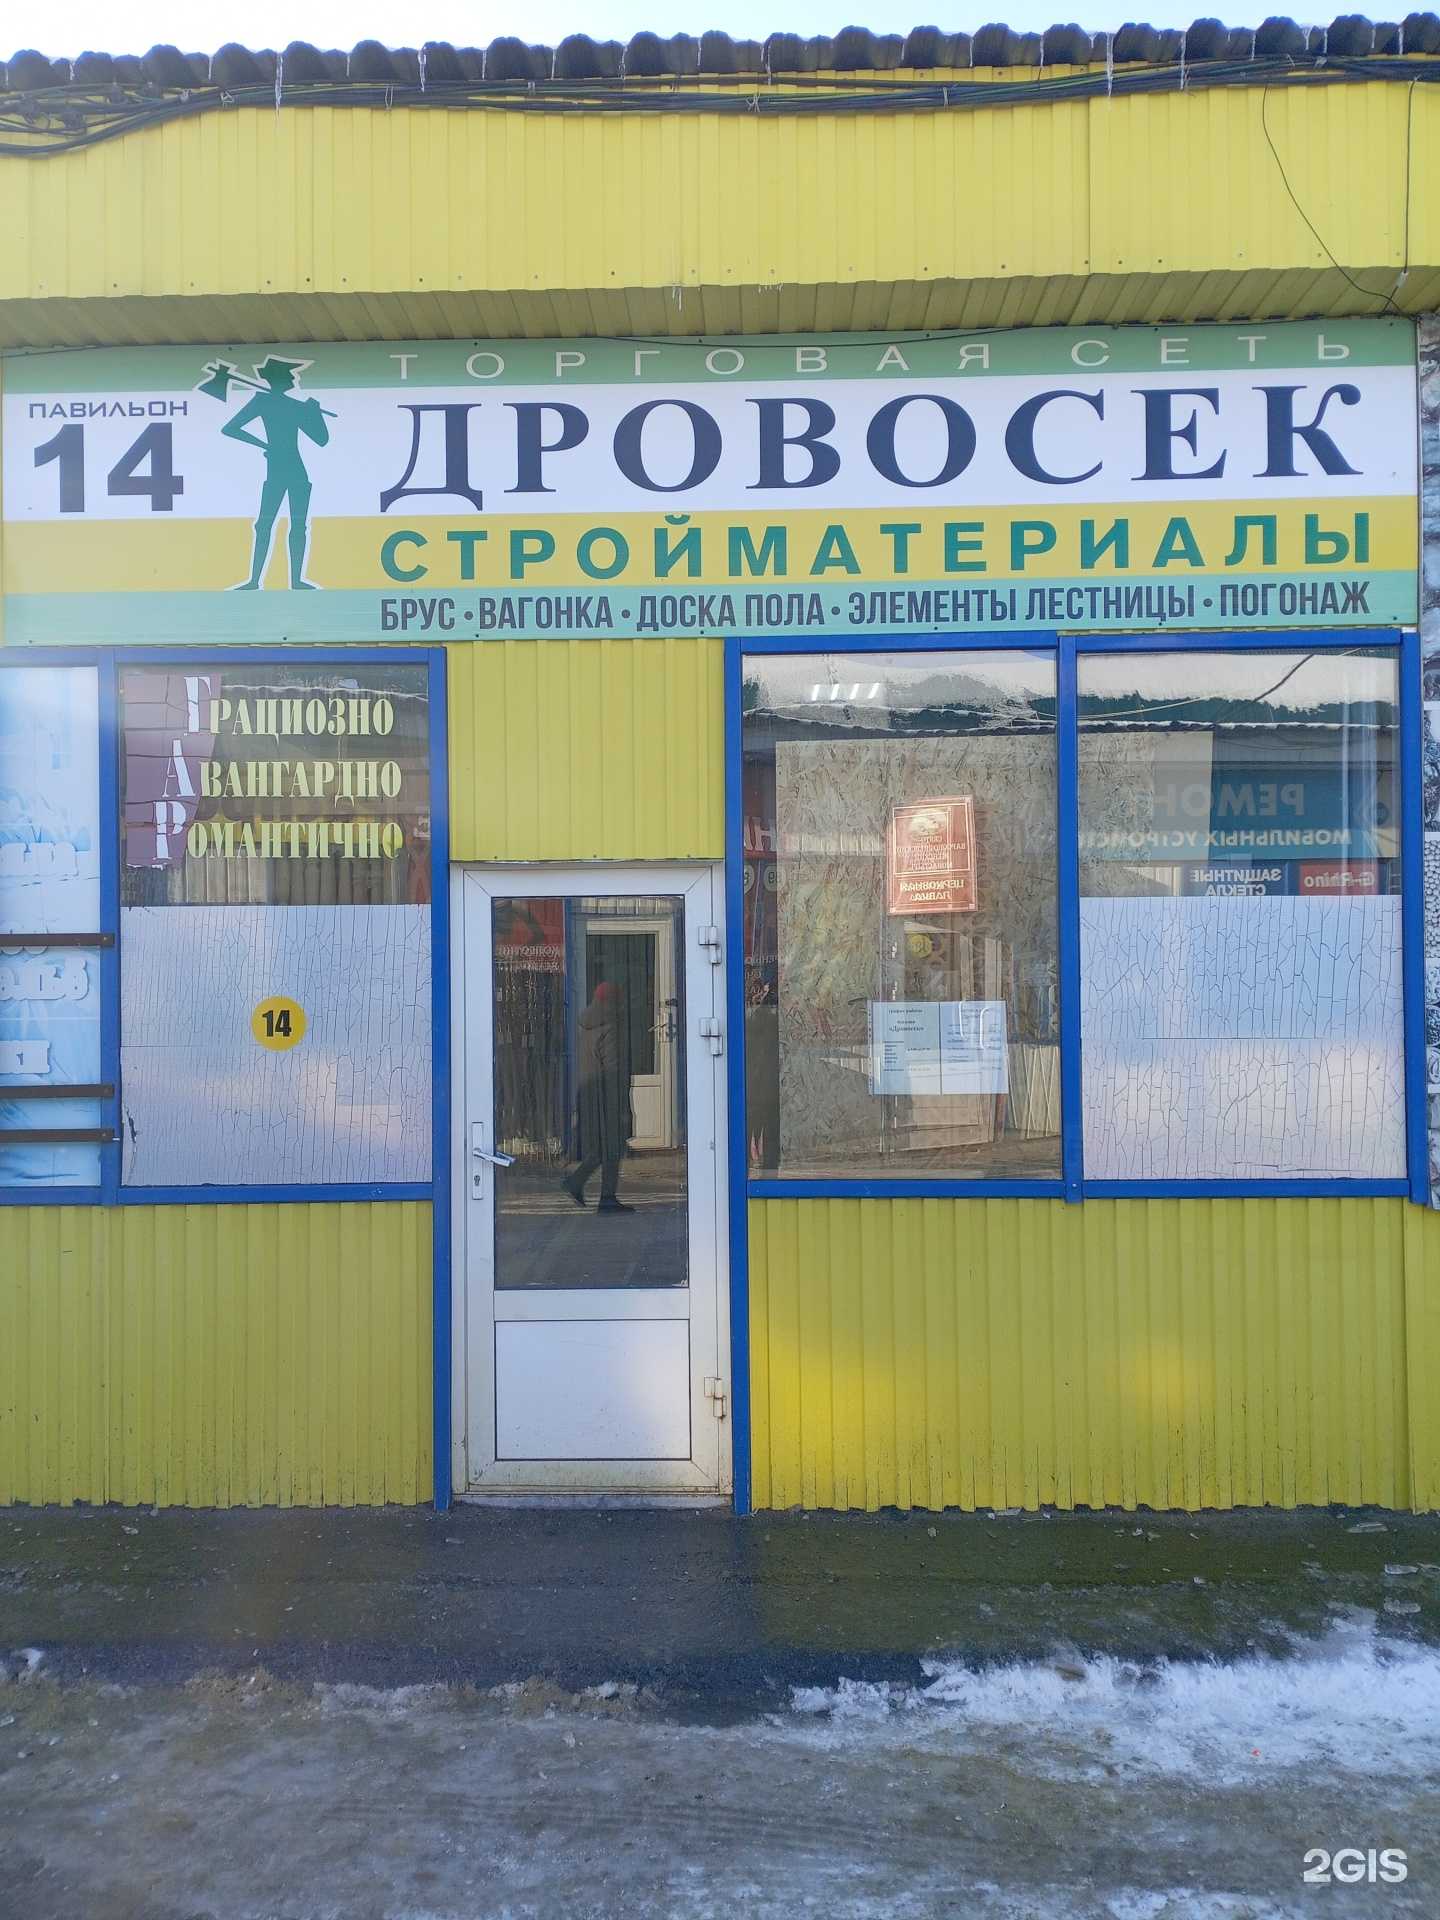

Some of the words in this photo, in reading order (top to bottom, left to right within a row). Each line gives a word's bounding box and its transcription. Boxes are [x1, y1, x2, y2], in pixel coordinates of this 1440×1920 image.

[390, 343, 991, 380] ТОРГОВАЯ
[1071, 335, 1350, 367] СЕТЬ
[28, 400, 188, 419] ПАВИЛЬОН
[34, 422, 184, 513] 14
[380, 383, 1363, 513] ДРОВОСЕК
[380, 512, 1370, 582] СТРОЙМАТЕРИАЛЫ
[381, 597, 456, 631] БРУС
[479, 595, 613, 630] ВАГОНКА
[637, 594, 736, 632] ДОСКА
[745, 592, 826, 627] ПОЛА
[848, 588, 1017, 625] ЭЛЕМЕНТЫ
[1024, 584, 1194, 624] ЛЕСТНИЦЫ
[1220, 580, 1371, 616] ПОГОНАЖ
[183, 675, 394, 745] ГРАЦИОЗНО
[161, 738, 402, 808] АВАНГАРДНО
[152, 800, 404, 860] РОМАНТИЧНО
[262, 1009, 292, 1037] 14
